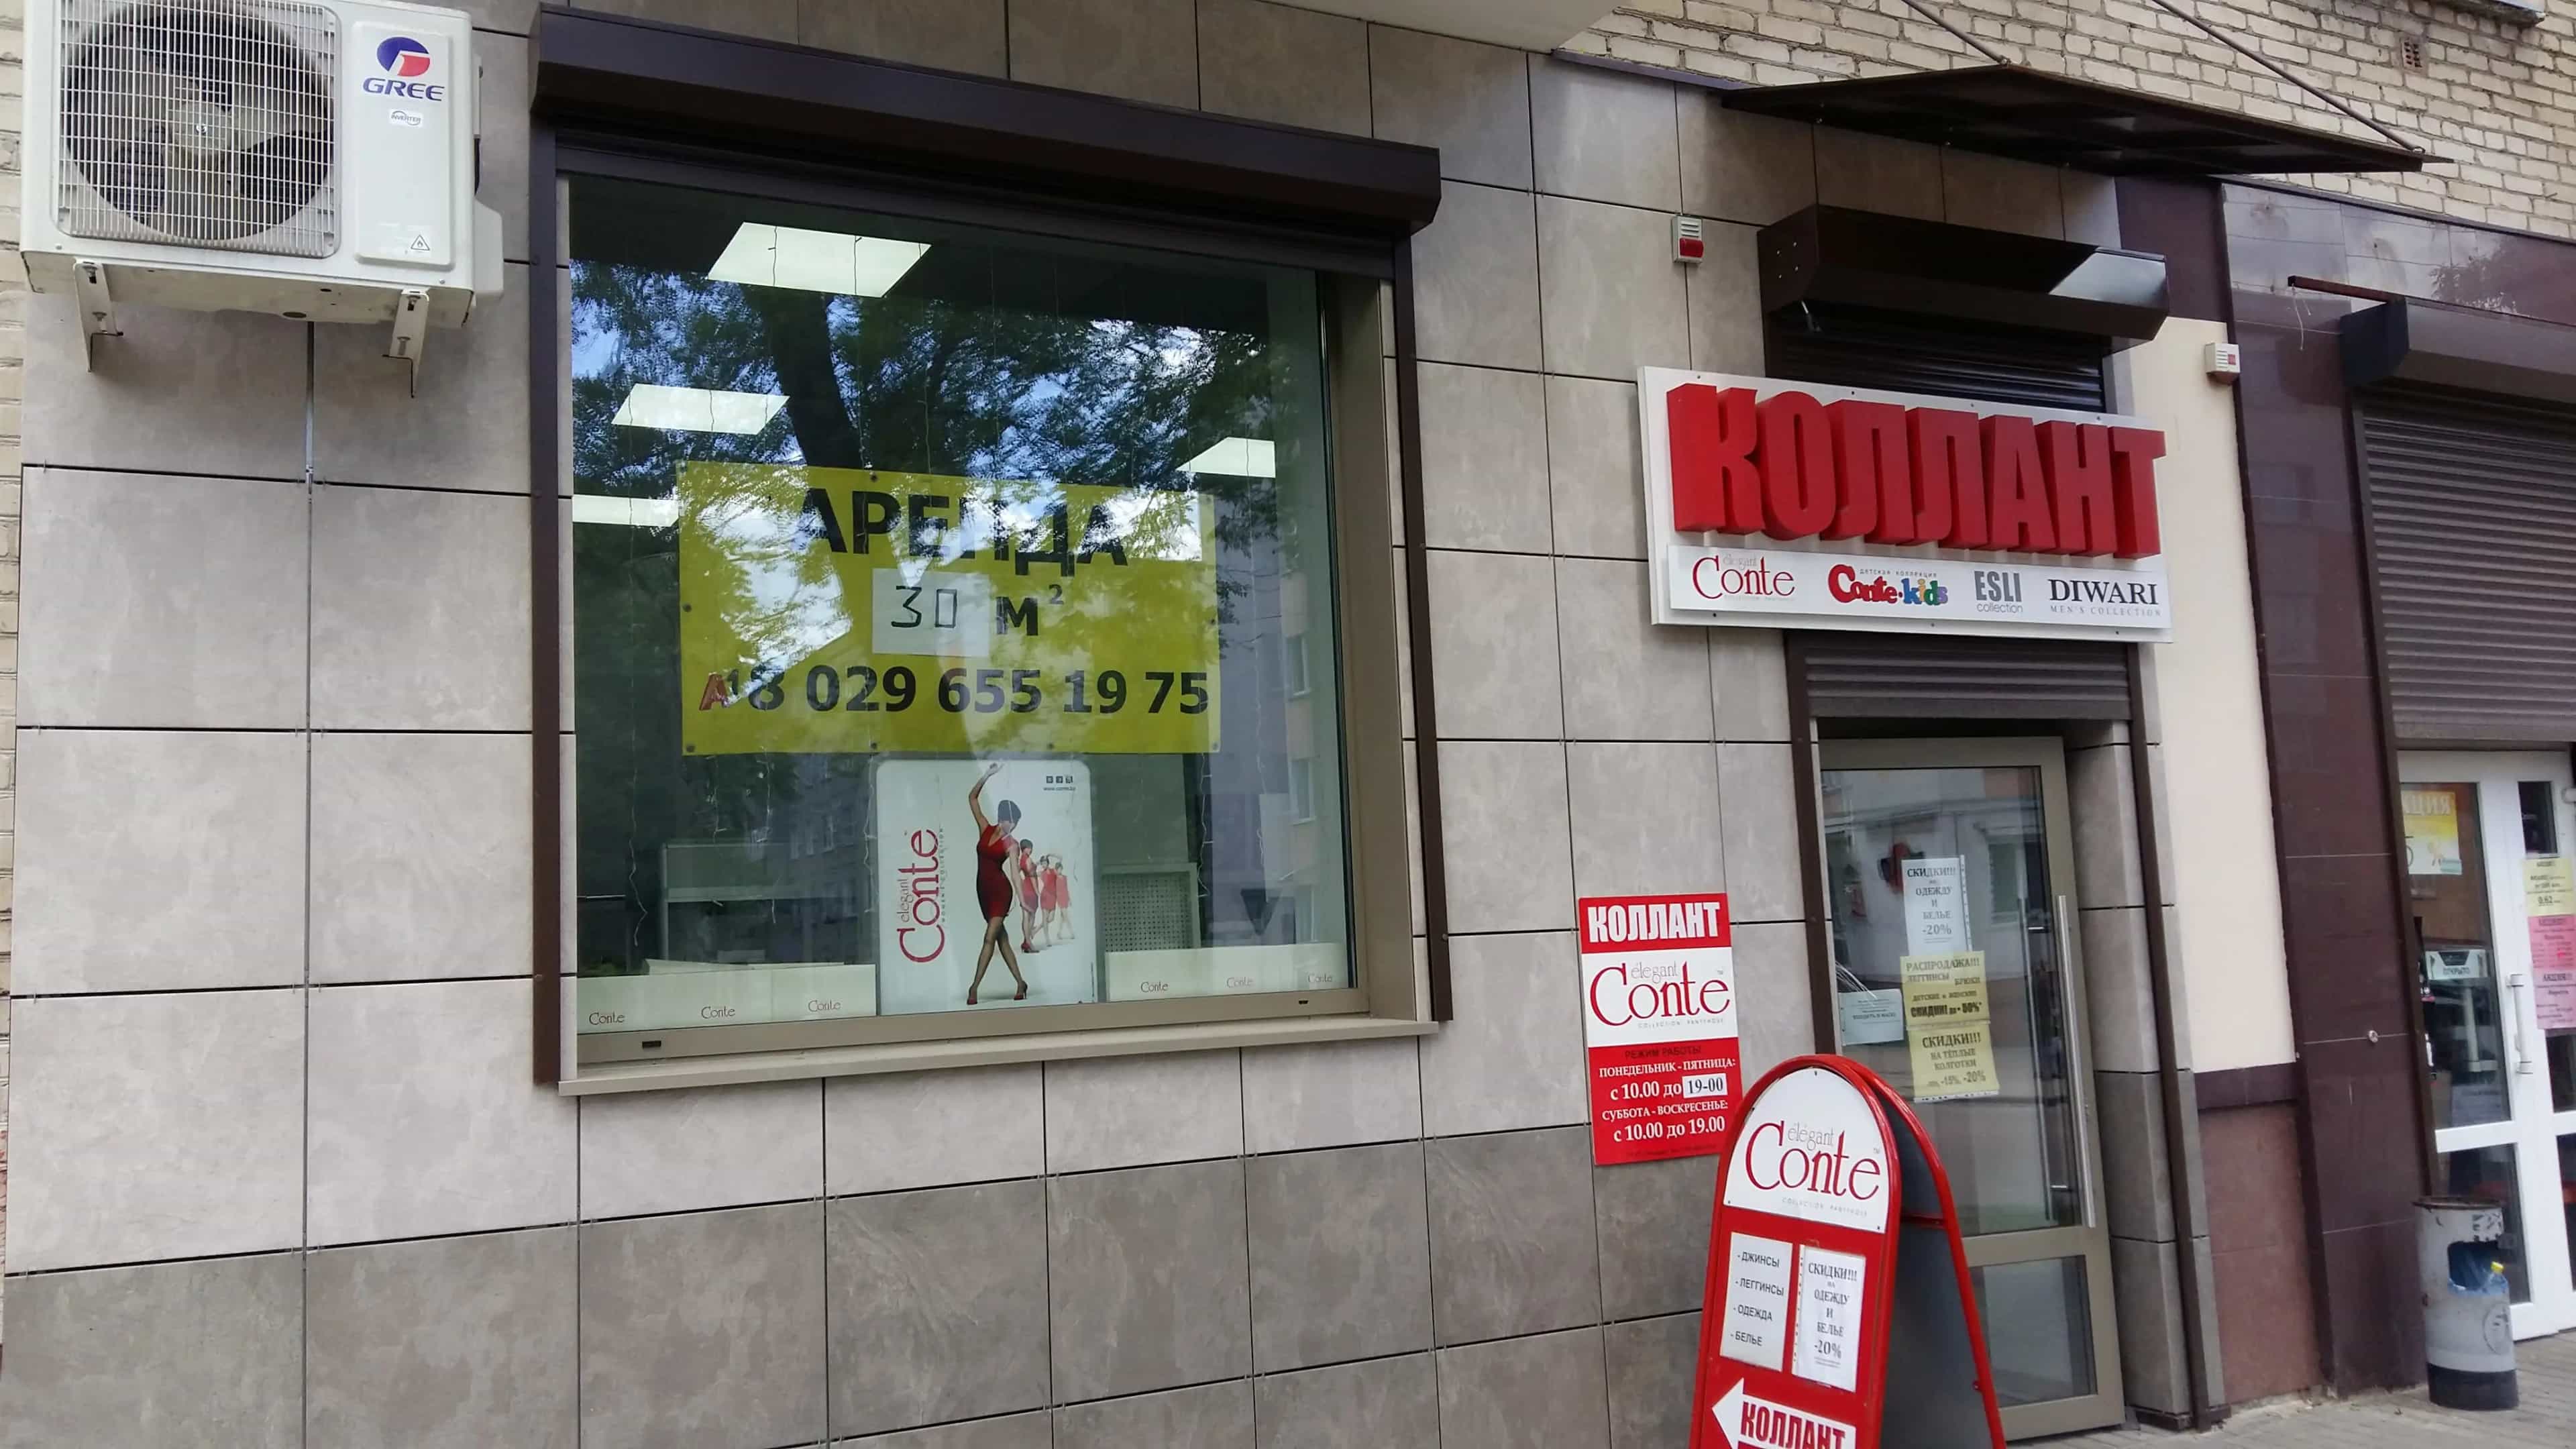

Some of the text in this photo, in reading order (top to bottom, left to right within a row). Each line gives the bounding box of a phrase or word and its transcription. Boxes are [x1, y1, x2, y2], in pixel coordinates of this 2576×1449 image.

[363, 78, 445, 101] GREE
[1666, 383, 2165, 559] КОЛЛАНТ
[798, 488, 1128, 577] АРЕНДА
[1693, 555, 1795, 599] Conte
[1974, 571, 2023, 602] ESLI
[2047, 579, 2159, 605] DIWARI
[891, 586, 957, 628] 30
[1976, 602, 2023, 613] collection
[2091, 606, 2161, 616] COLLECTION
[806, 665, 916, 712] 029
[938, 668, 1041, 714] 655
[1064, 669, 1127, 714] 19
[1145, 672, 1208, 714] 75
[897, 830, 945, 963] Conte
[1915, 886, 1952, 896] ОДЕЖДУ
[1587, 901, 1721, 943] КОЛЛАНТ
[1922, 924, 1951, 934] -20%
[1140, 981, 1169, 993] Conte
[1590, 961, 1730, 1026] Conte
[589, 1012, 625, 1026] Conte
[701, 1006, 736, 1020] Conte
[1922, 1032, 1981, 1048] СКИДКИ!!!
[1625, 1046, 1702, 1059] РЕЖИМ РАБОТЫ
[1599, 1062, 1676, 1077] ПОНЕДЕЛЬНИК
[1683, 1058, 1736, 1071] ПЯТНИЦА:
[1621, 1081, 1660, 1099] 10.00
[1663, 1083, 1682, 1097] до
[1688, 1077, 1723, 1094] 19-00
[1602, 1108, 1650, 1122] СУББОТА
[1658, 1099, 1729, 1116] ВОСКРЕСЕНЬЕ:
[1625, 1122, 1663, 1140] 10.00
[1666, 1124, 1685, 1138] до
[1688, 1116, 1725, 1134] 19.00
[1746, 1120, 1880, 1201] Conte
[1808, 1262, 1857, 1281] СКИДКИ!!!
[1814, 1289, 1849, 1305] ОДЕЖДУ
[1826, 1307, 1833, 1318] И
[1817, 1322, 1844, 1337] БЕЛЬЕ
[1814, 1340, 1842, 1359] -20%
[1741, 1401, 1846, 1449] КОЛЛАНТ
